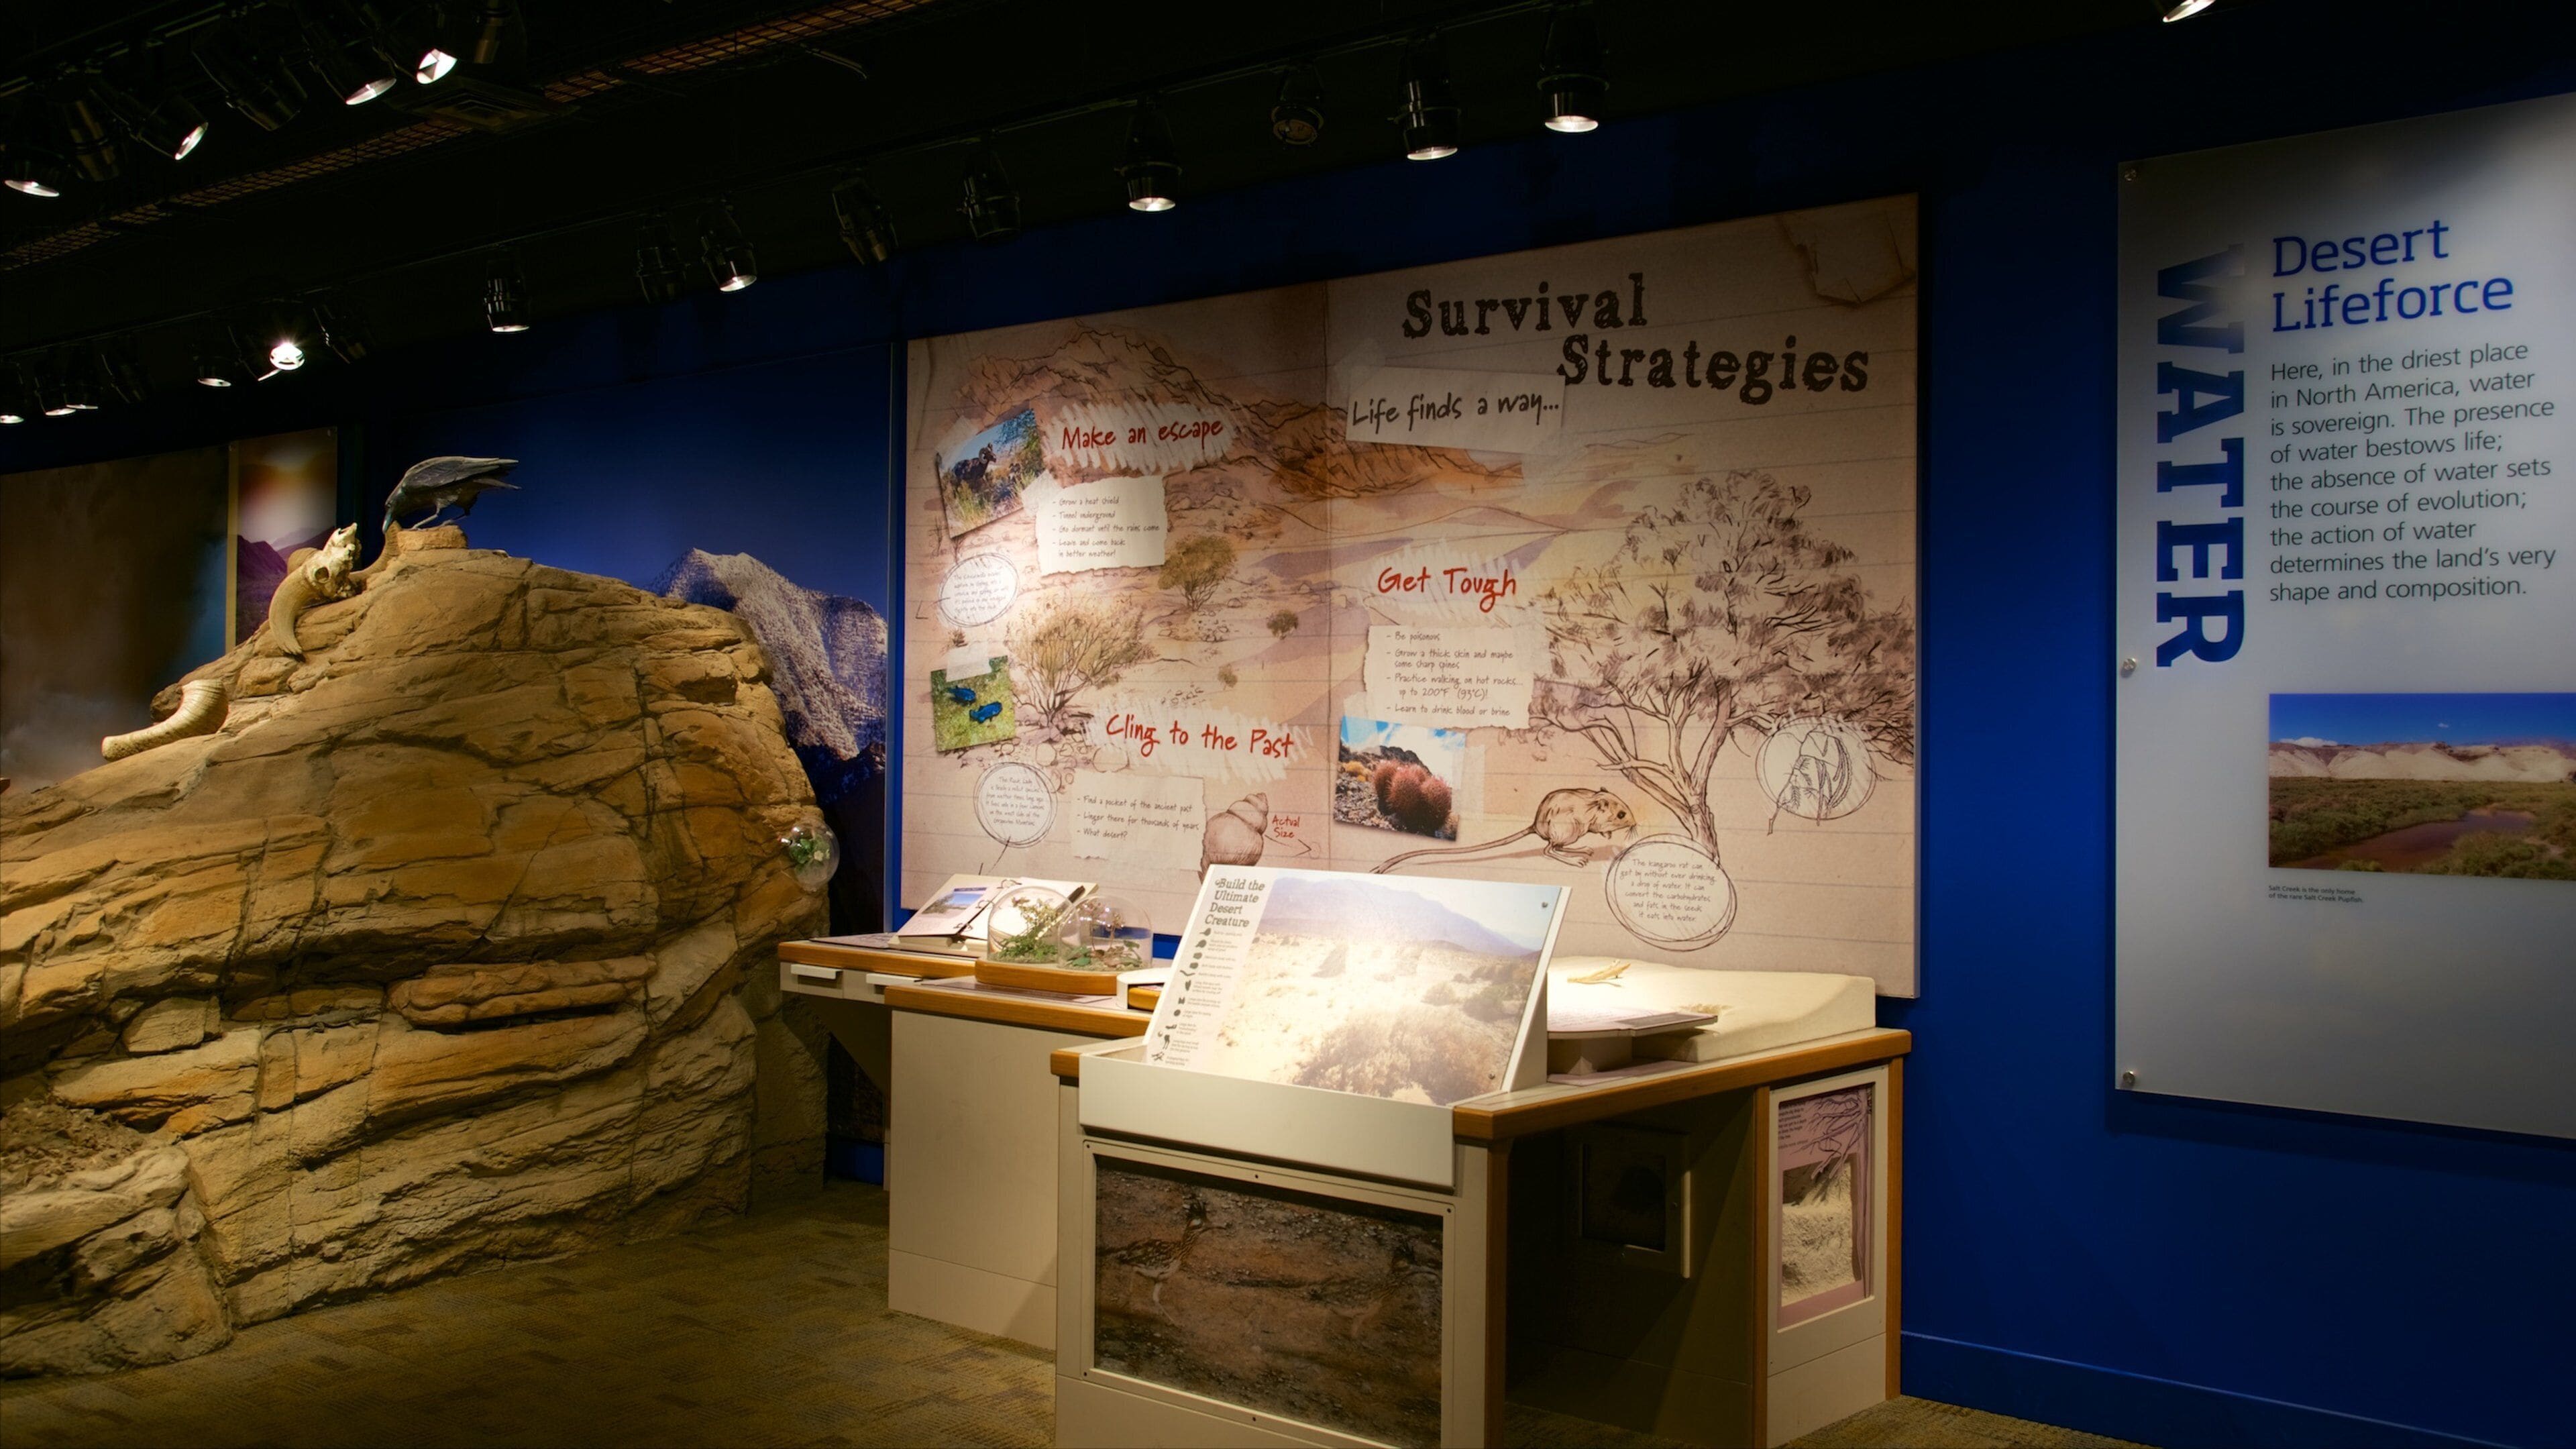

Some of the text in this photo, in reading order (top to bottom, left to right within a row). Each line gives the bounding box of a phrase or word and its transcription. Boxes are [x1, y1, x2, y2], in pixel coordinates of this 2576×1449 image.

[2273, 220, 2449, 277] Desert
[1402, 273, 1648, 338] Survival
[2272, 276, 2513, 332] Lifeforce
[1556, 335, 1870, 405] Strategies
[2271, 343, 2529, 381] Here, in the driest place
[2271, 372, 2535, 409] in North America, water
[1352, 392, 1560, 433] Life finds a way...
[2271, 400, 2555, 436] is sovereign. The presence
[1062, 420, 1223, 450] Make an escape
[2157, 244, 2245, 667] WATER
[2271, 431, 2504, 464] of water bestows life;
[2271, 458, 2552, 492] the absence of water sets
[1059, 498, 1077, 506] Grow
[2271, 488, 2528, 519] the course of evolution;
[2271, 520, 2477, 546] the action of water
[2269, 546, 2557, 574] determines the land's very
[1377, 567, 1517, 612] Get Tough
[2269, 574, 2527, 604] shape and composition.
[1395, 631, 1440, 645] Be poisonous
[1395, 649, 1417, 657] Grow
[1430, 649, 1450, 658] thick
[1454, 649, 1470, 658] skin
[1474, 650, 1487, 658] and
[1491, 650, 1513, 663] maybe
[1417, 660, 1435, 672] sharp
[1439, 661, 1459, 672] spines
[1395, 674, 1426, 682] Practice
[1431, 674, 1459, 690] walking
[1477, 675, 1489, 684] hot
[1493, 677, 1523, 685] rocks...
[1399, 690, 1405, 698] up
[1458, 689, 1488, 701] (93°C)!
[1395, 704, 1416, 712] Learn
[1432, 705, 1452, 714] drink
[1456, 706, 1474, 714] blood
[1492, 707, 1510, 716] brine
[1107, 715, 1293, 757] Cling to the Past
[1083, 796, 1096, 804] Find
[1106, 798, 1126, 810] pocket
[1130, 800, 1136, 810] of
[1180, 805, 1192, 814] past
[1083, 812, 1103, 825] Linger
[1108, 813, 1124, 822] there
[1128, 816, 1138, 826] for
[1173, 820, 1179, 830] of
[1183, 823, 1199, 832] years
[1272, 816, 1300, 828] Actual
[1083, 828, 1128, 841] What desert?
[1274, 826, 1295, 839] Size
[1649, 860, 1676, 871] kangaroo
[1219, 879, 1265, 890] Build the
[1620, 869, 1632, 879] get
[1635, 870, 1642, 881] by
[1689, 873, 1717, 885] drinking
[1638, 881, 1650, 891] drop
[1653, 881, 1660, 892] of
[1214, 891, 1258, 902] Ultimate
[1667, 893, 1711, 902] carbohydrates
[1210, 902, 1242, 913] Desert
[1647, 902, 1658, 912] fats
[1205, 914, 1250, 926] Creature
